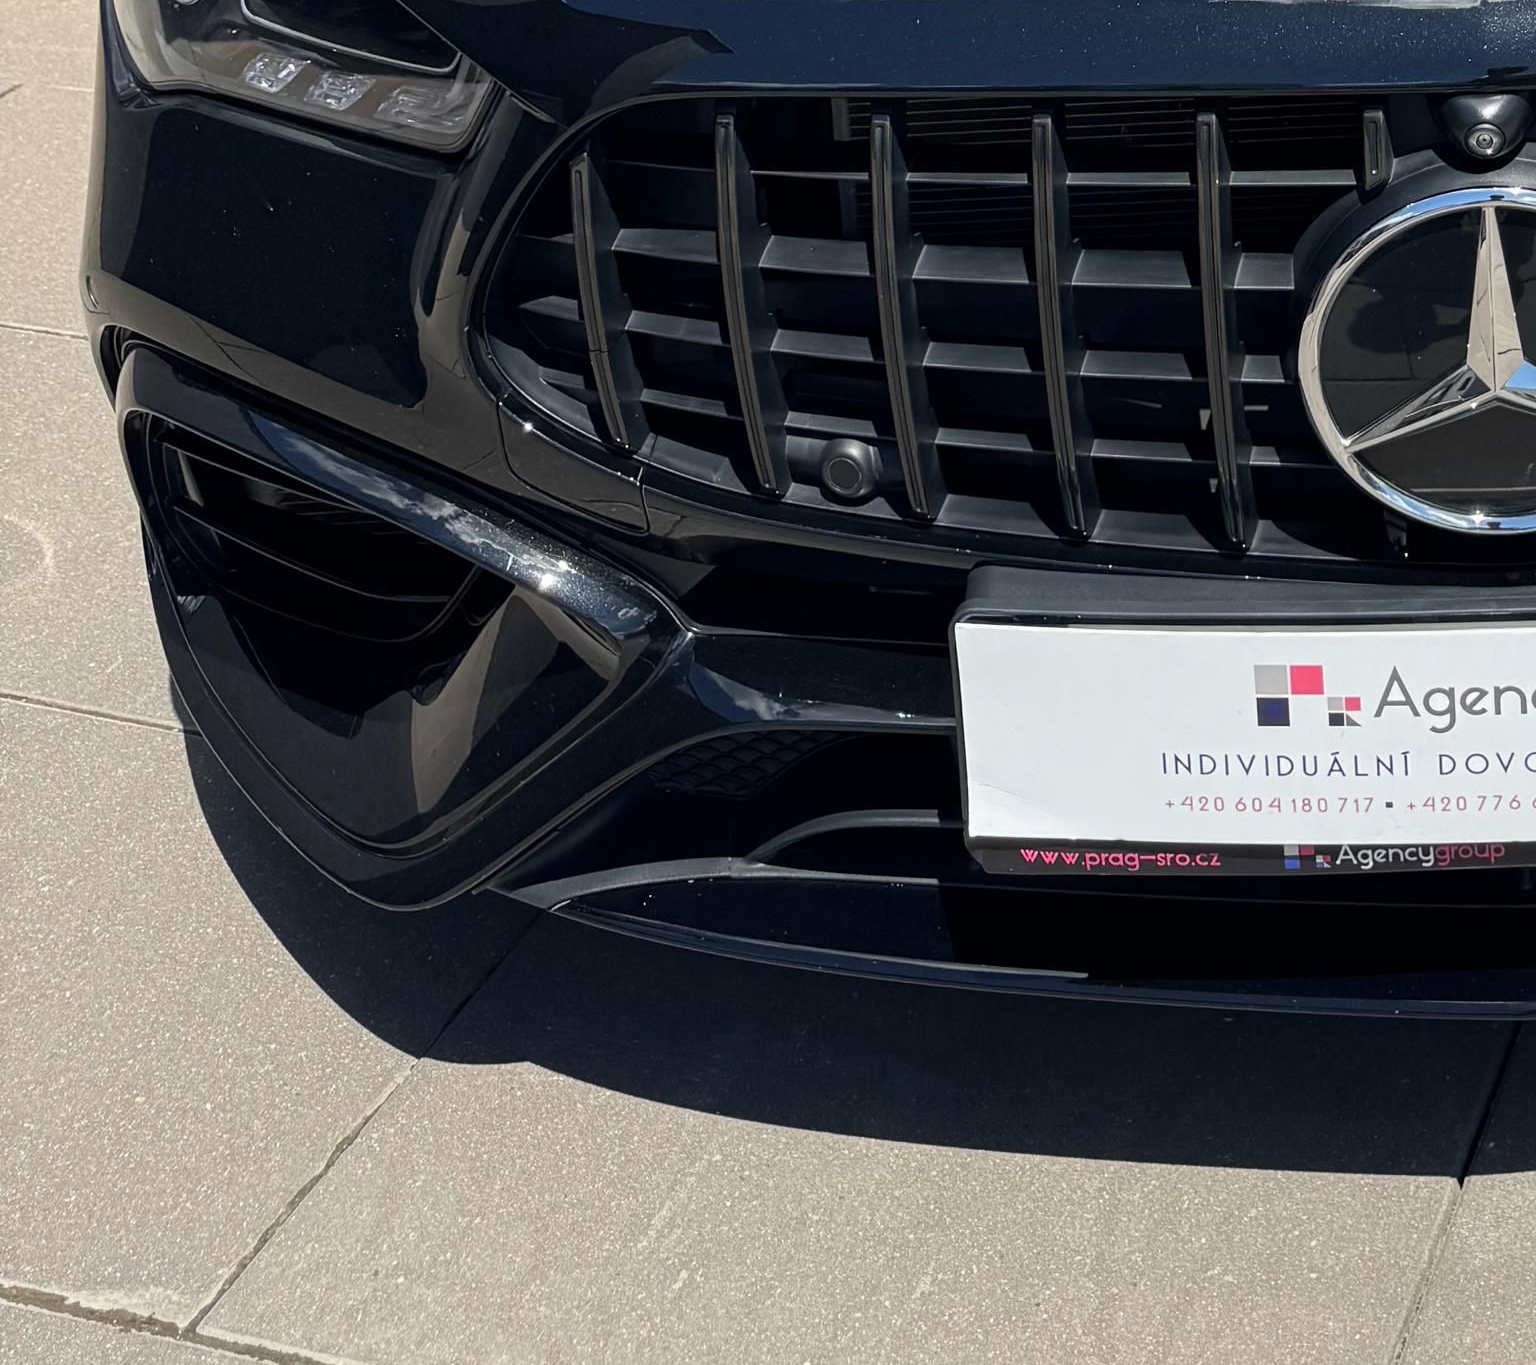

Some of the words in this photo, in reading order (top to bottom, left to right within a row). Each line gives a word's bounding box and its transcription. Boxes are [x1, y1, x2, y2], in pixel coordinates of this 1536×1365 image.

[1162, 751, 1411, 777] INDIVIDUÁLNÍ
[1020, 847, 1221, 871] www.prag-sro.cz
[1336, 843, 1506, 870] Agencygroup
